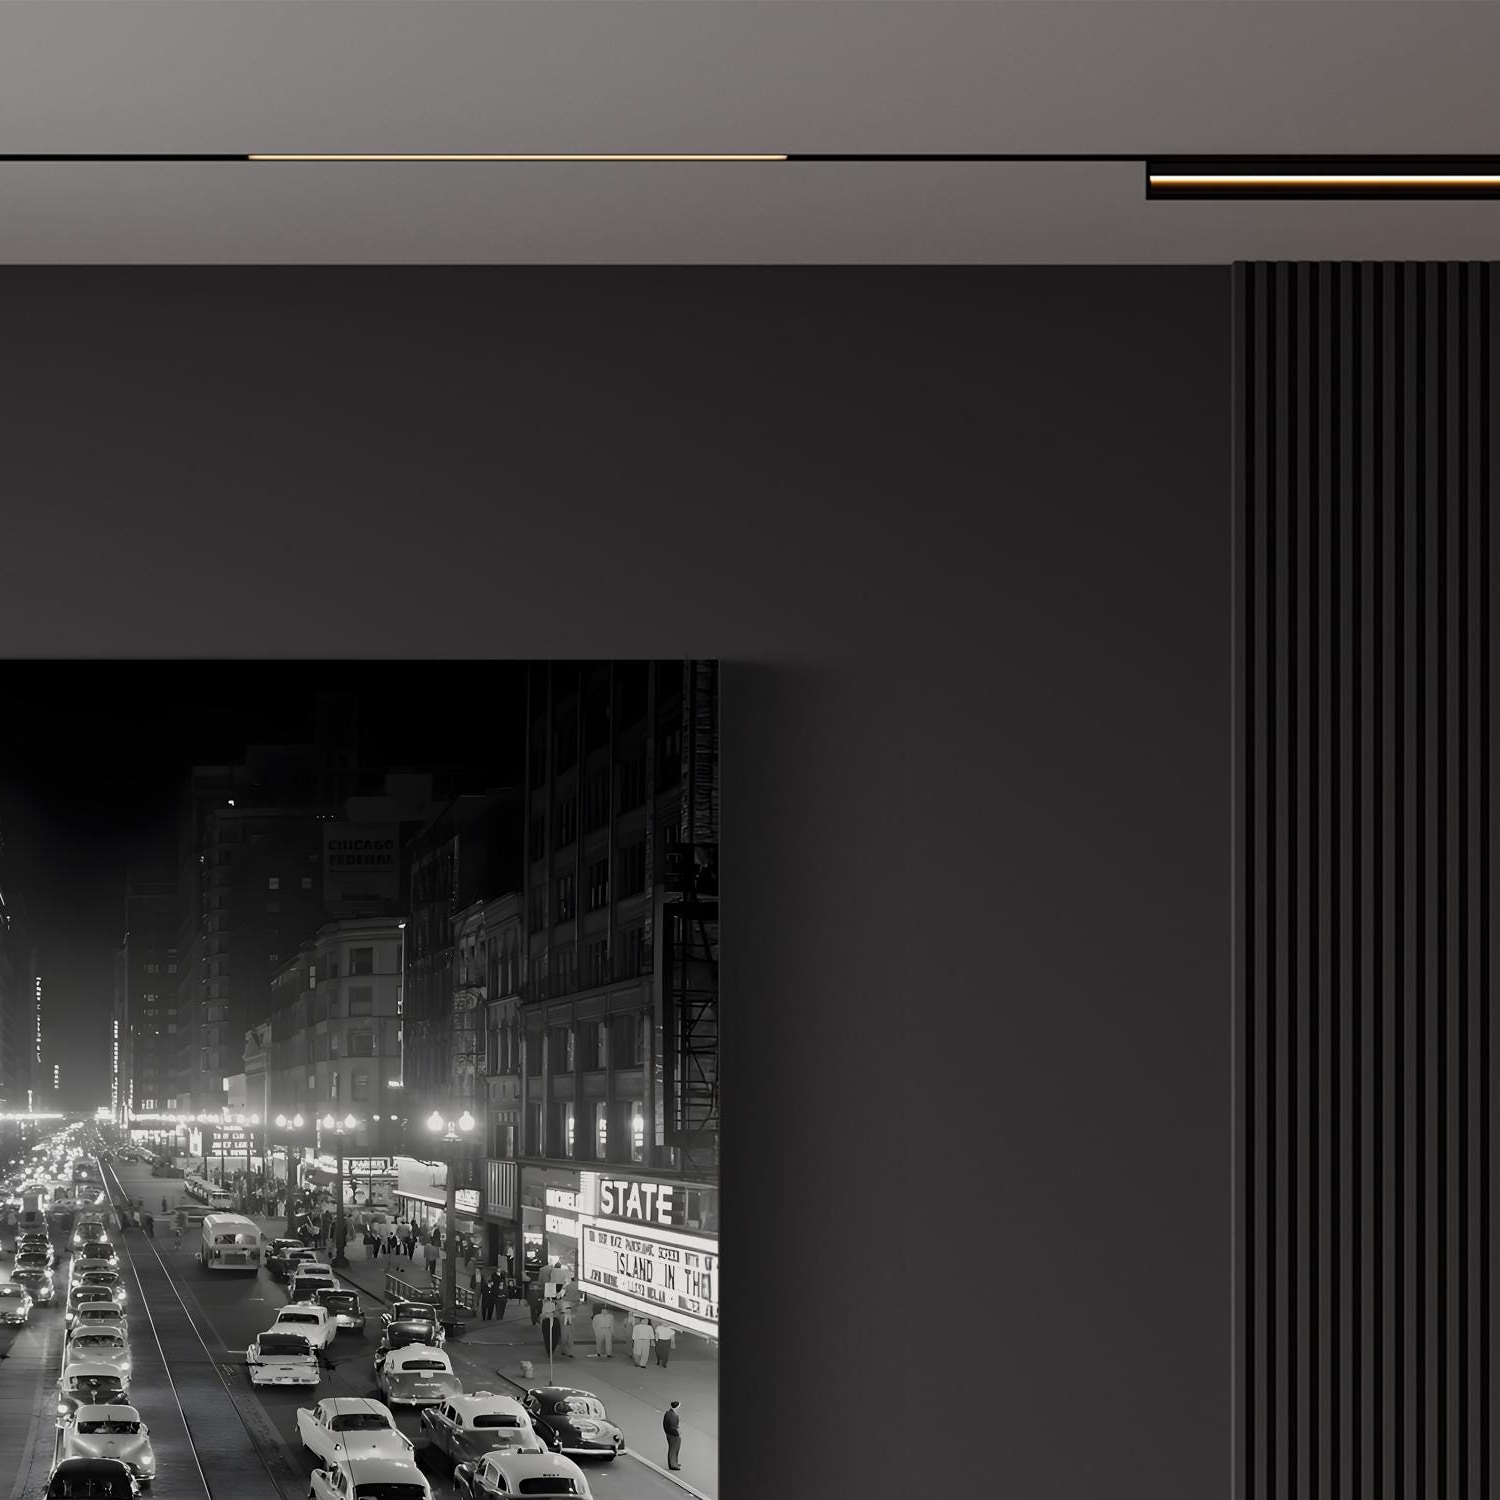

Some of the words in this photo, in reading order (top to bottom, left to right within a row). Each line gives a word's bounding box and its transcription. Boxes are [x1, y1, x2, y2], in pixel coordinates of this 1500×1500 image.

[600, 1180, 674, 1225] STATE
[613, 1250, 654, 1283] ISLAND
[664, 1263, 675, 1290] IN
